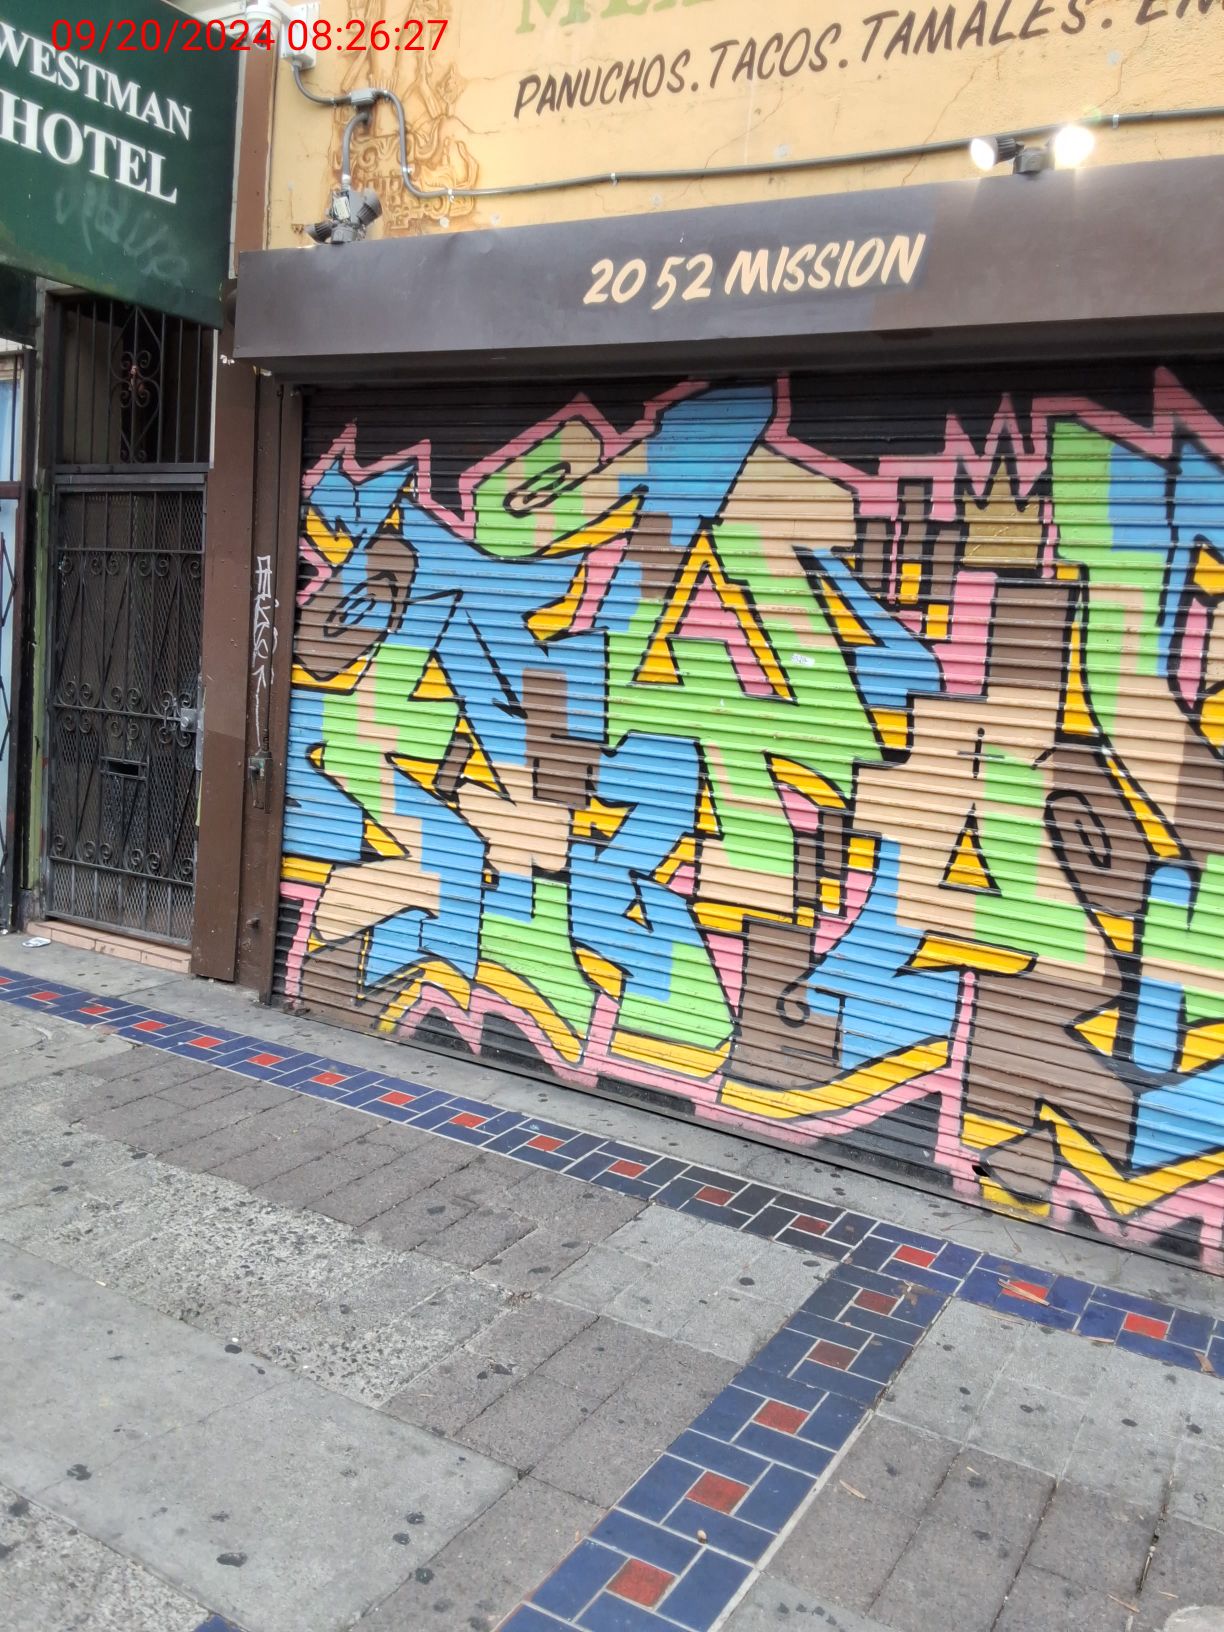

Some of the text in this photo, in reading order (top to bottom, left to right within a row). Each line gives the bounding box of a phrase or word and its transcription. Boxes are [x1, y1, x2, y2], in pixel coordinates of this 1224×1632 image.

[0, 21, 192, 141] WESTMAN
[0, 88, 178, 204] HOTEL
[724, 233, 926, 295] MISSION
